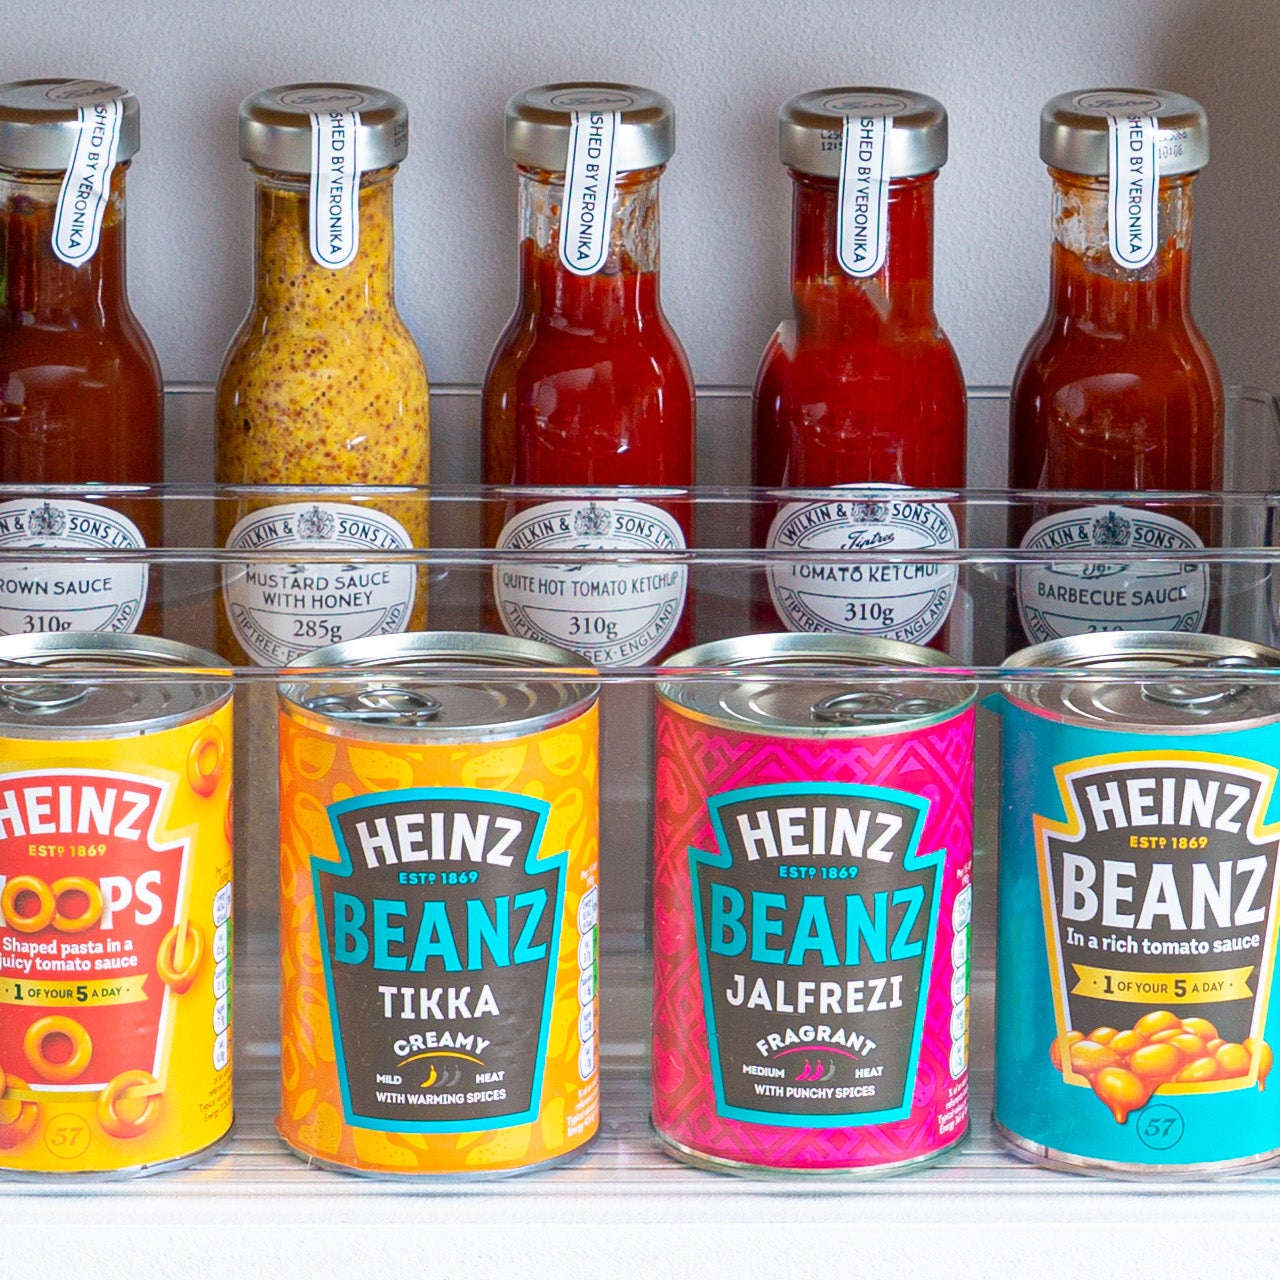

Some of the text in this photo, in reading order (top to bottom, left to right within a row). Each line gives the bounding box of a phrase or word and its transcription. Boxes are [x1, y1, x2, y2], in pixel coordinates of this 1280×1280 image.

[329, 176, 344, 257] VERONIKA
[852, 187, 871, 263] VERONIKA
[54, 578, 112, 594] SAUCE
[246, 571, 390, 591] MUSTARD SAUCE
[263, 591, 373, 609] WITH HONEY
[1037, 583, 1126, 607] BARBECUE
[293, 620, 342, 643] 285g
[569, 615, 618, 639] 310g
[1087, 779, 1252, 834] HEINZ
[354, 812, 523, 870] HEINZ
[737, 808, 904, 863] HEINZ
[1172, 835, 1208, 849] 1869
[1061, 852, 1270, 933] BEANZ
[332, 889, 549, 973] BEANZ
[710, 883, 926, 968] BEANZ
[3, 937, 103, 958] Shaped pasta
[1101, 933, 1260, 955] rich tomato sauce
[35, 958, 91, 971] tomato
[95, 955, 137, 970] sauce
[378, 984, 501, 1020] TIKKA
[726, 974, 903, 1015] JALFREZI
[394, 1031, 491, 1056] CREAMY
[756, 1026, 876, 1059] FRAGRANT
[376, 1071, 505, 1085] MILD HEAT
[376, 1089, 506, 1104] WITH WARMING SPICES
